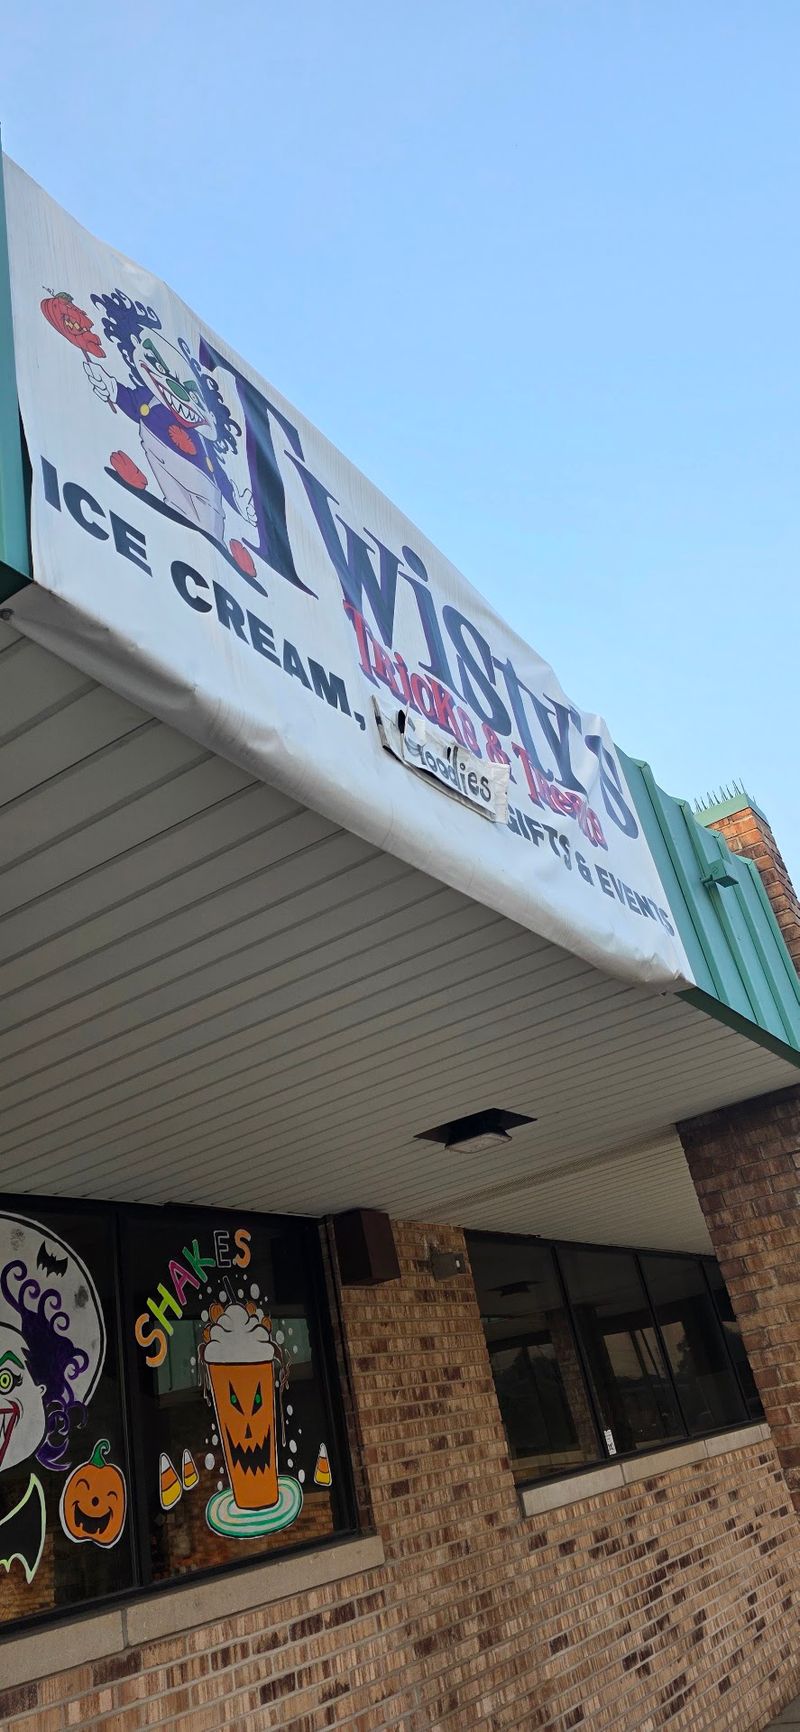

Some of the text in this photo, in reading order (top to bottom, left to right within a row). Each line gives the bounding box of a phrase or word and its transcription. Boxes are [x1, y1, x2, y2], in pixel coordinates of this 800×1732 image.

[40, 455, 675, 937] ICE CREAM, GIFTS & EVENTS
[199, 333, 639, 841] Twisty's
[481, 722, 518, 784] &
[134, 1228, 253, 1368] SHAKES
